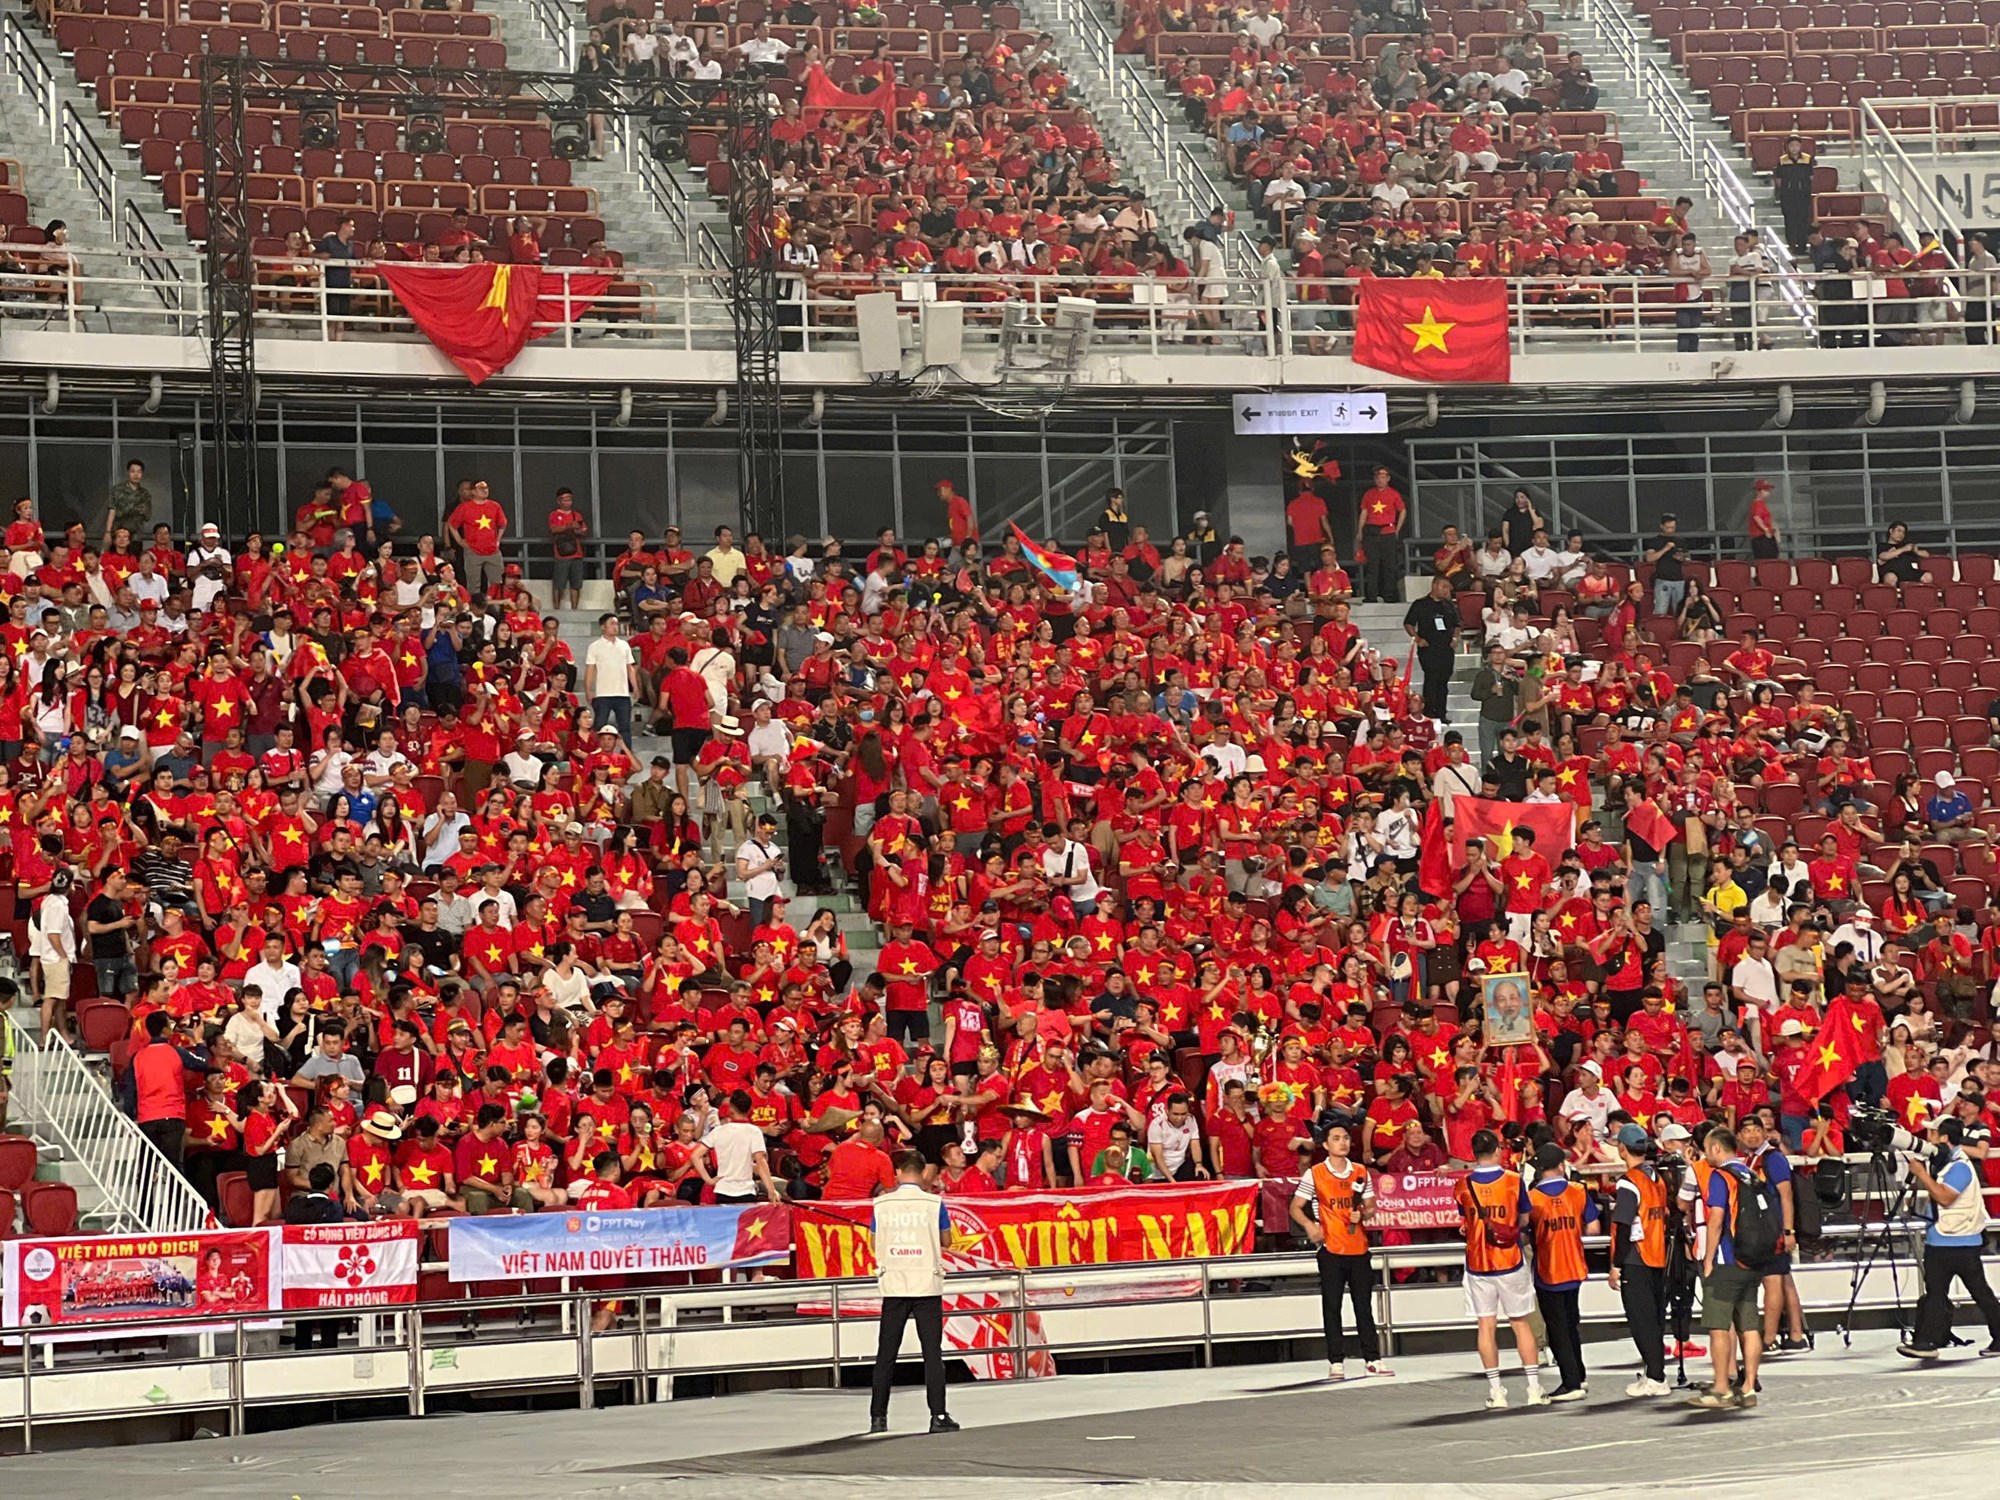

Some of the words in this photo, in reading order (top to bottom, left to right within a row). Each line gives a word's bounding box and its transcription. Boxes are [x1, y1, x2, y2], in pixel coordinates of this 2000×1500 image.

[1300, 409, 1320, 417] EXIT
[1389, 817, 1405, 832] NIKE
[397, 1066, 411, 1080] 11
[1417, 1176, 1437, 1187] FPT
[1406, 1195, 1431, 1206] VIÊN
[1431, 1196, 1453, 1206] VFS
[602, 1218, 622, 1229] FPT
[623, 1217, 646, 1229] Play
[345, 1225, 366, 1240] VIÊN
[57, 1244, 93, 1262] VIỆT
[96, 1245, 133, 1258] NAM
[137, 1241, 158, 1255] VÔ
[161, 1239, 200, 1257] ĐỊCH
[889, 1247, 923, 1256] Canon
[502, 1249, 541, 1276] VIỆT
[545, 1251, 585, 1272] NAM
[590, 1243, 645, 1271] QUYẾT
[649, 1239, 707, 1267] THẮNG
